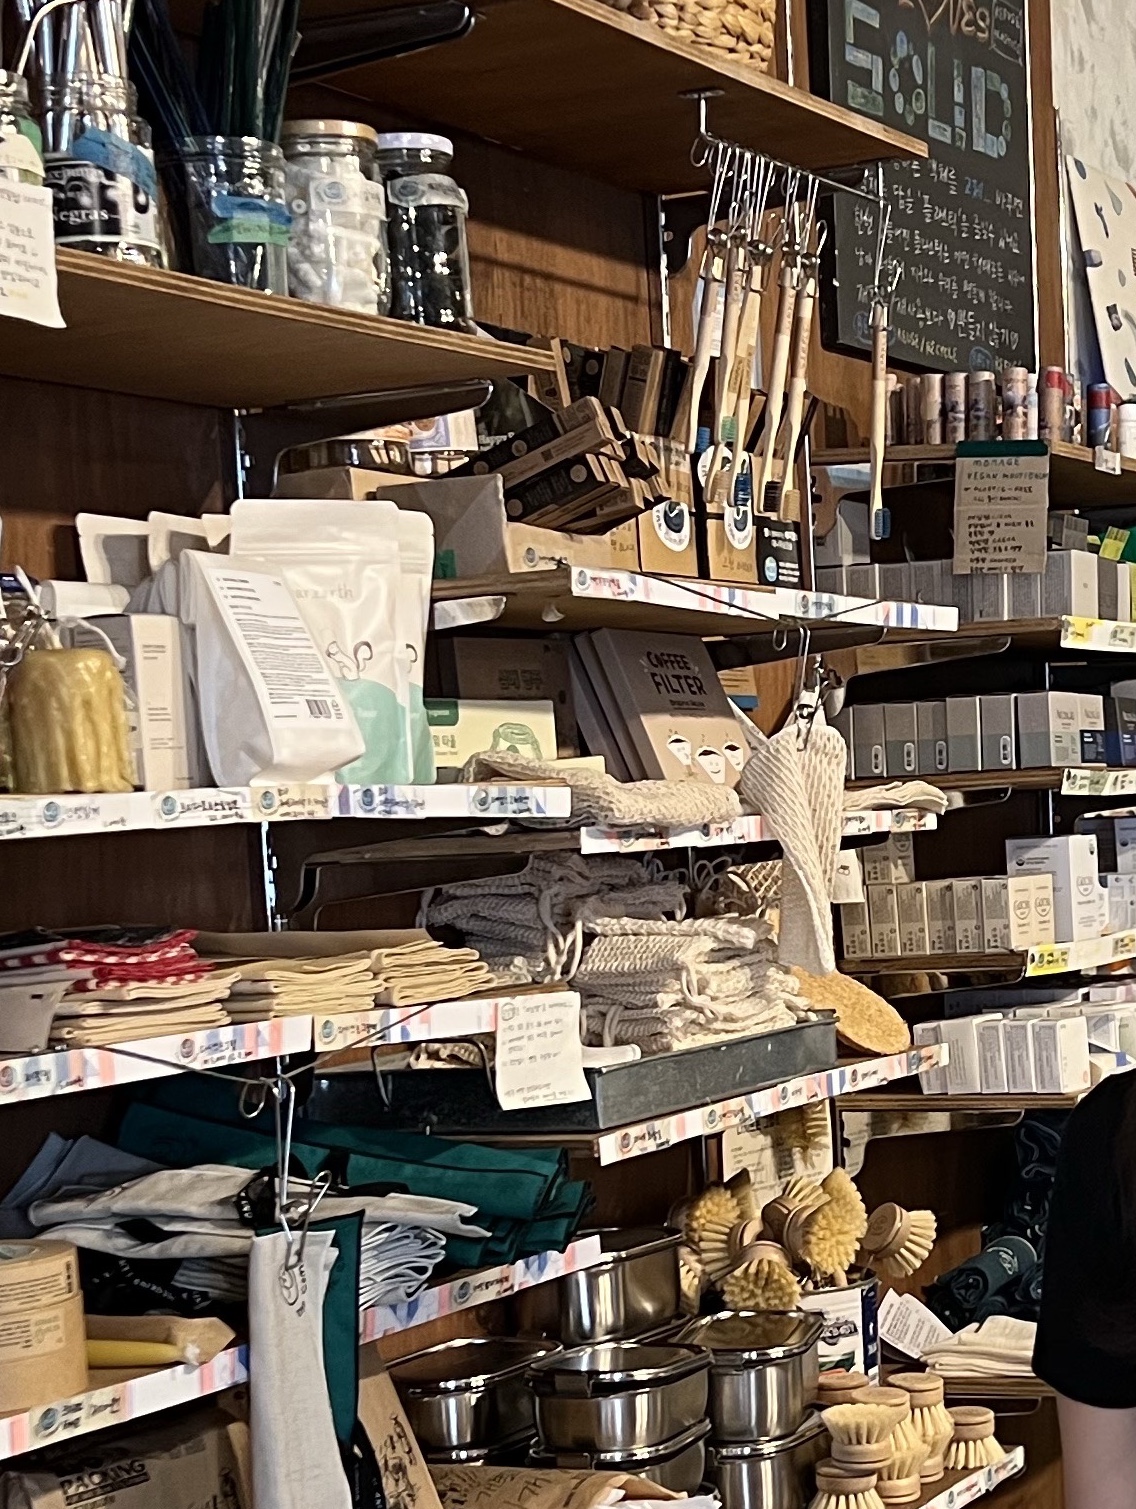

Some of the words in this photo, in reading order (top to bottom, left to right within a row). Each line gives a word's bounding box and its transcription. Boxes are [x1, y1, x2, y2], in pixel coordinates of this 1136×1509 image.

[845, 0, 1012, 158] SOLID
[646, 651, 691, 671] COFFEE
[650, 672, 707, 696] FILTER
